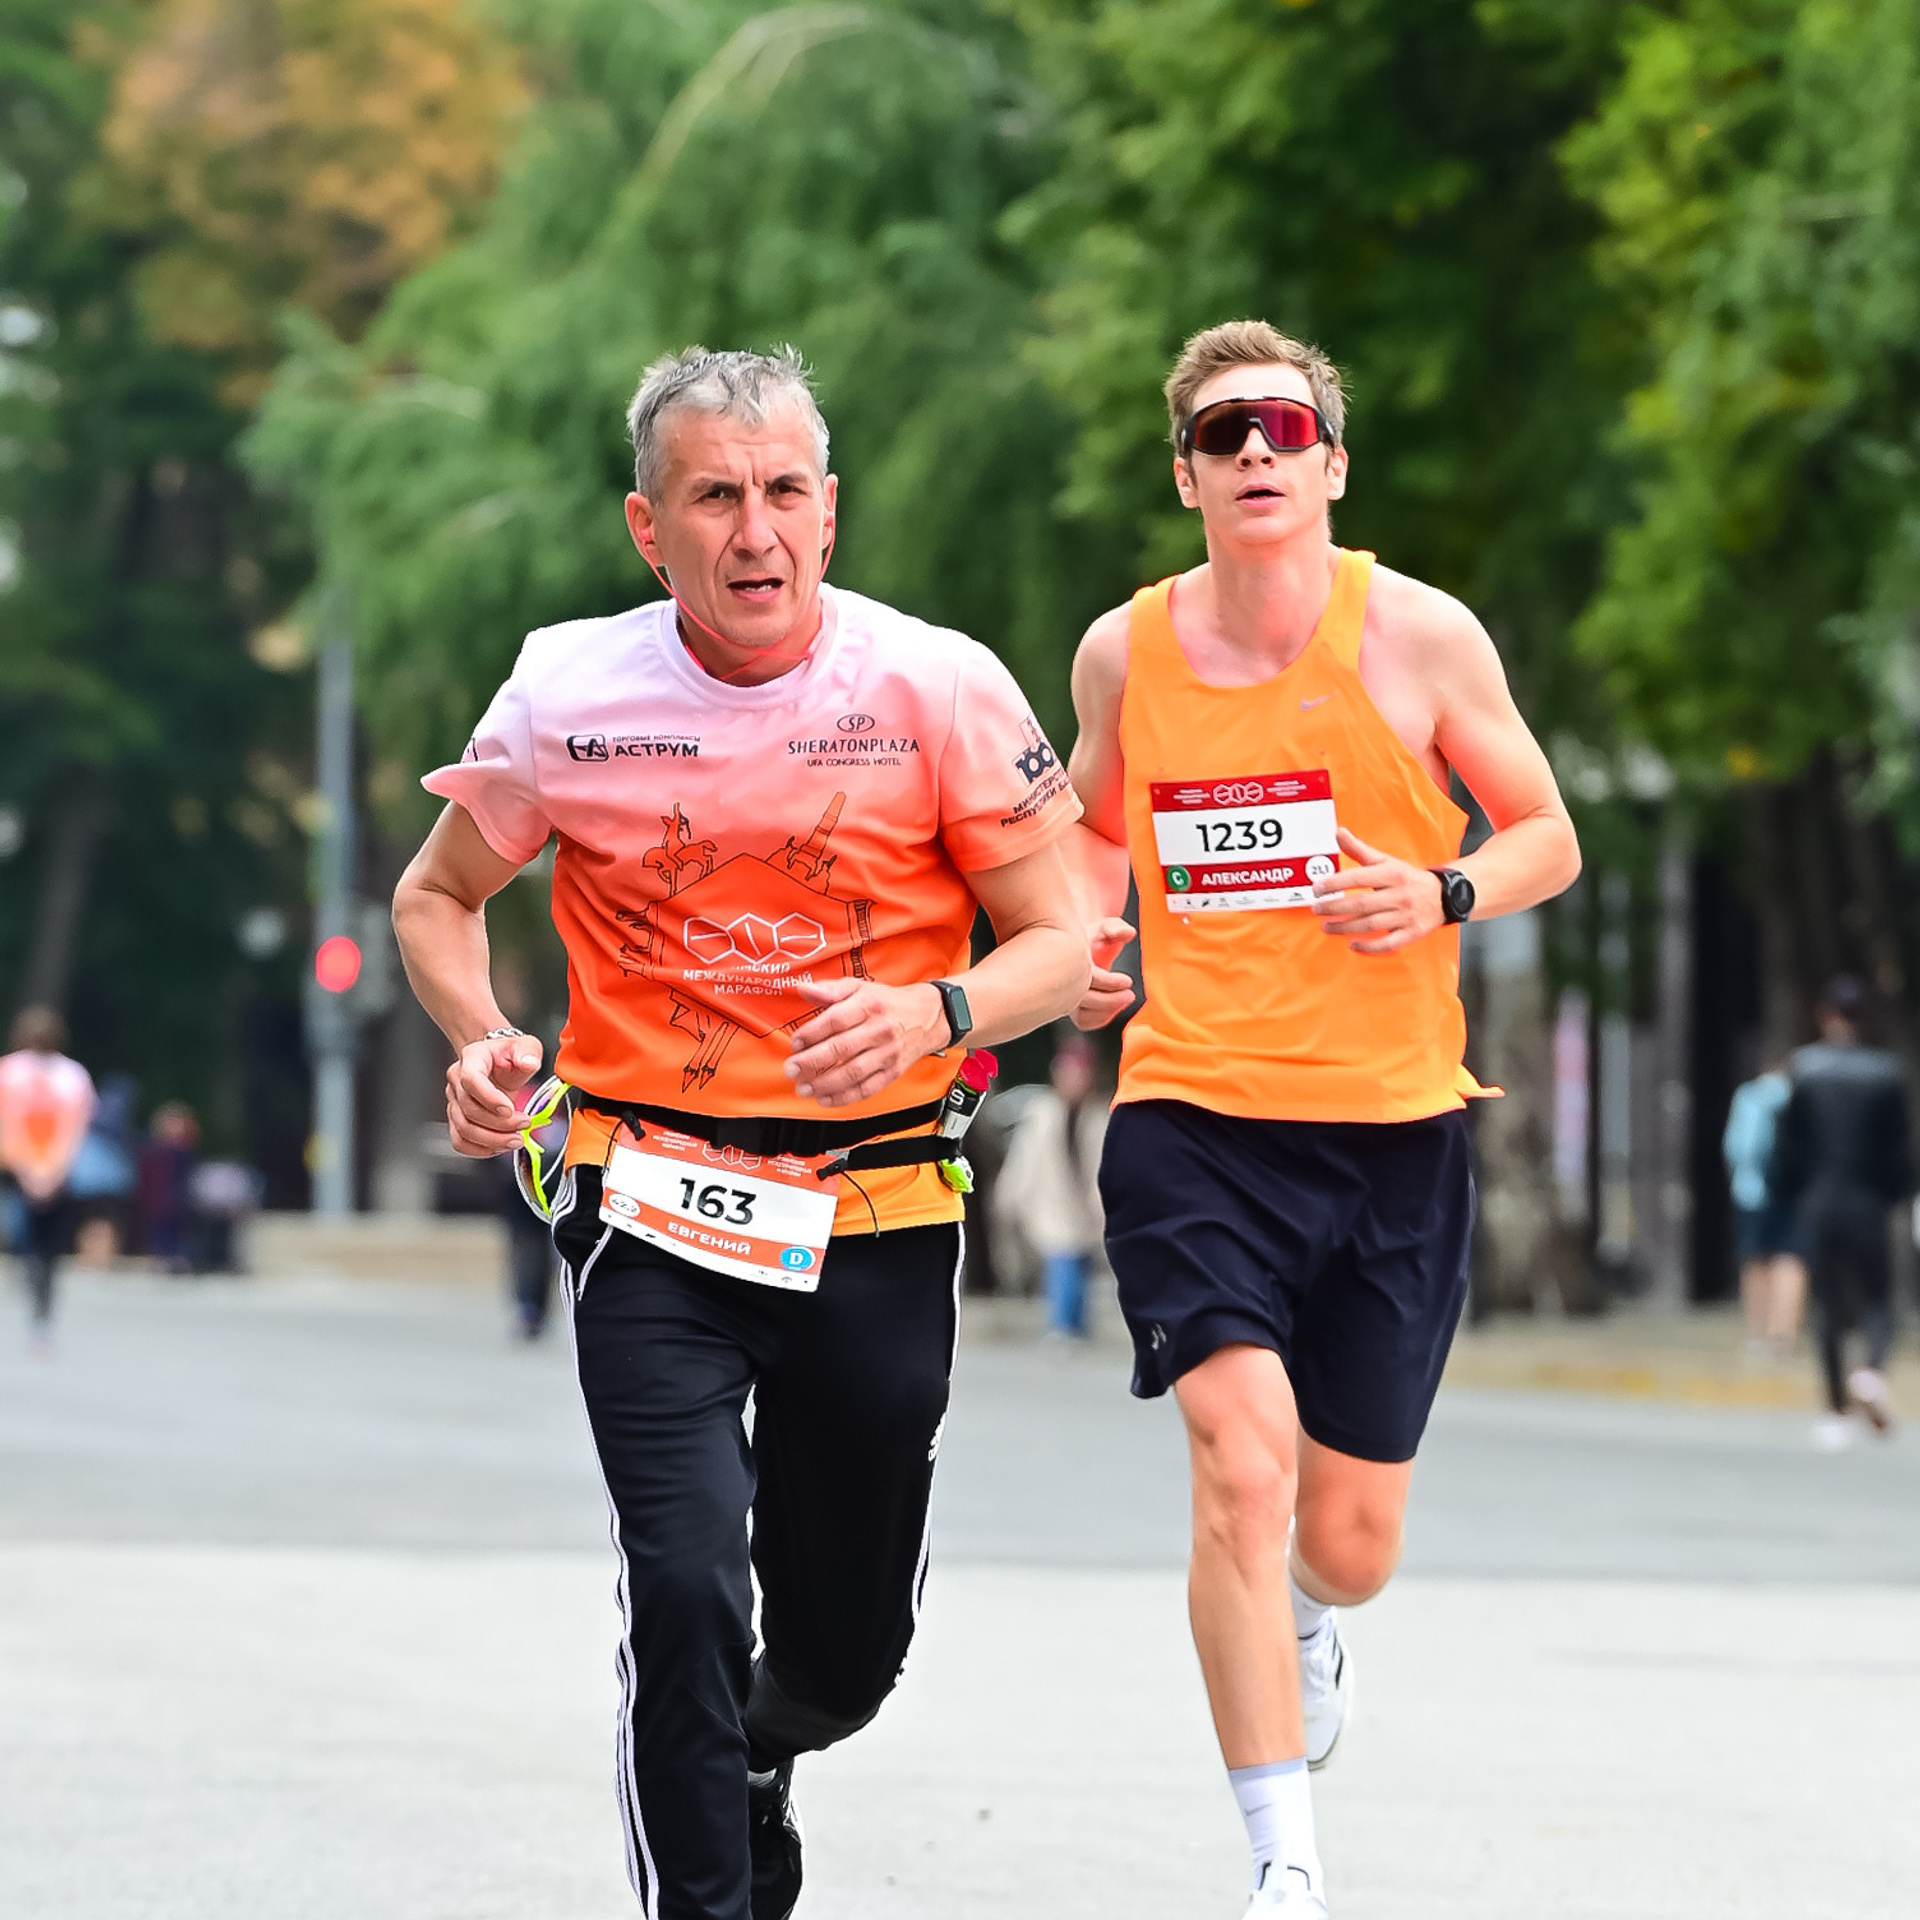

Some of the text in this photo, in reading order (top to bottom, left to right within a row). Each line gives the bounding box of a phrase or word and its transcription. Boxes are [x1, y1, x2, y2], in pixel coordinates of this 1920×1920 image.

[614, 742, 699, 757] АСТРУМ
[788, 738, 920, 754] SHERATONPLAZA
[873, 757, 902, 766] HOTEL
[1196, 819, 1283, 852] 1239
[1201, 867, 1294, 886] АЛЕКСАНДР
[683, 969, 814, 991] МЕЖДУНАРОДНЫЙ
[680, 1177, 757, 1226] 163
[667, 1221, 752, 1256] ЕВГЕНИЙ
[789, 1252, 804, 1265] D
